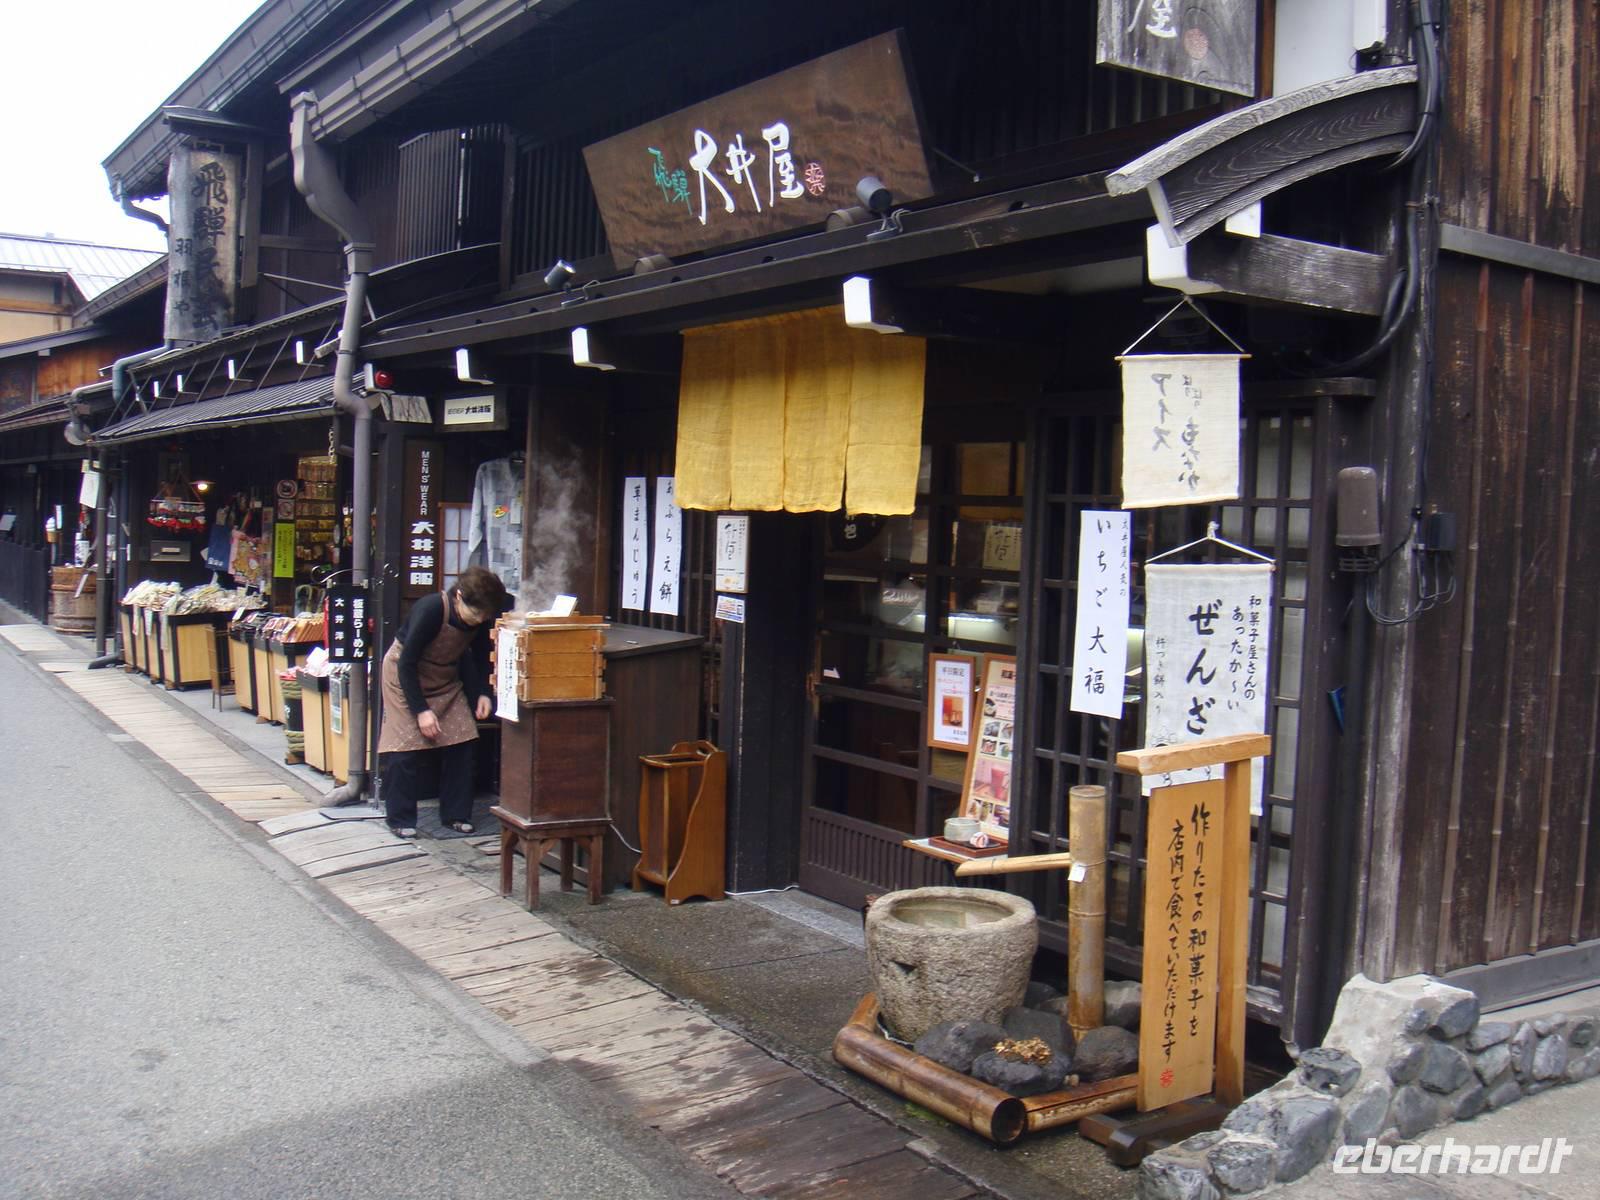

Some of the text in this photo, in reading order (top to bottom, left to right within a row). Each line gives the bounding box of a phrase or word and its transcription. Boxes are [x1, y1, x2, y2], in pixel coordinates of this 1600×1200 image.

[1085, 518, 1111, 695] いちご大福
[1186, 598, 1222, 736] ぜんざ
[1244, 595, 1262, 701] 和菓子屋さんの
[1162, 818, 1184, 1063] 店内で食べていただけます
[1188, 801, 1211, 1037] 作りたての和菓子を
